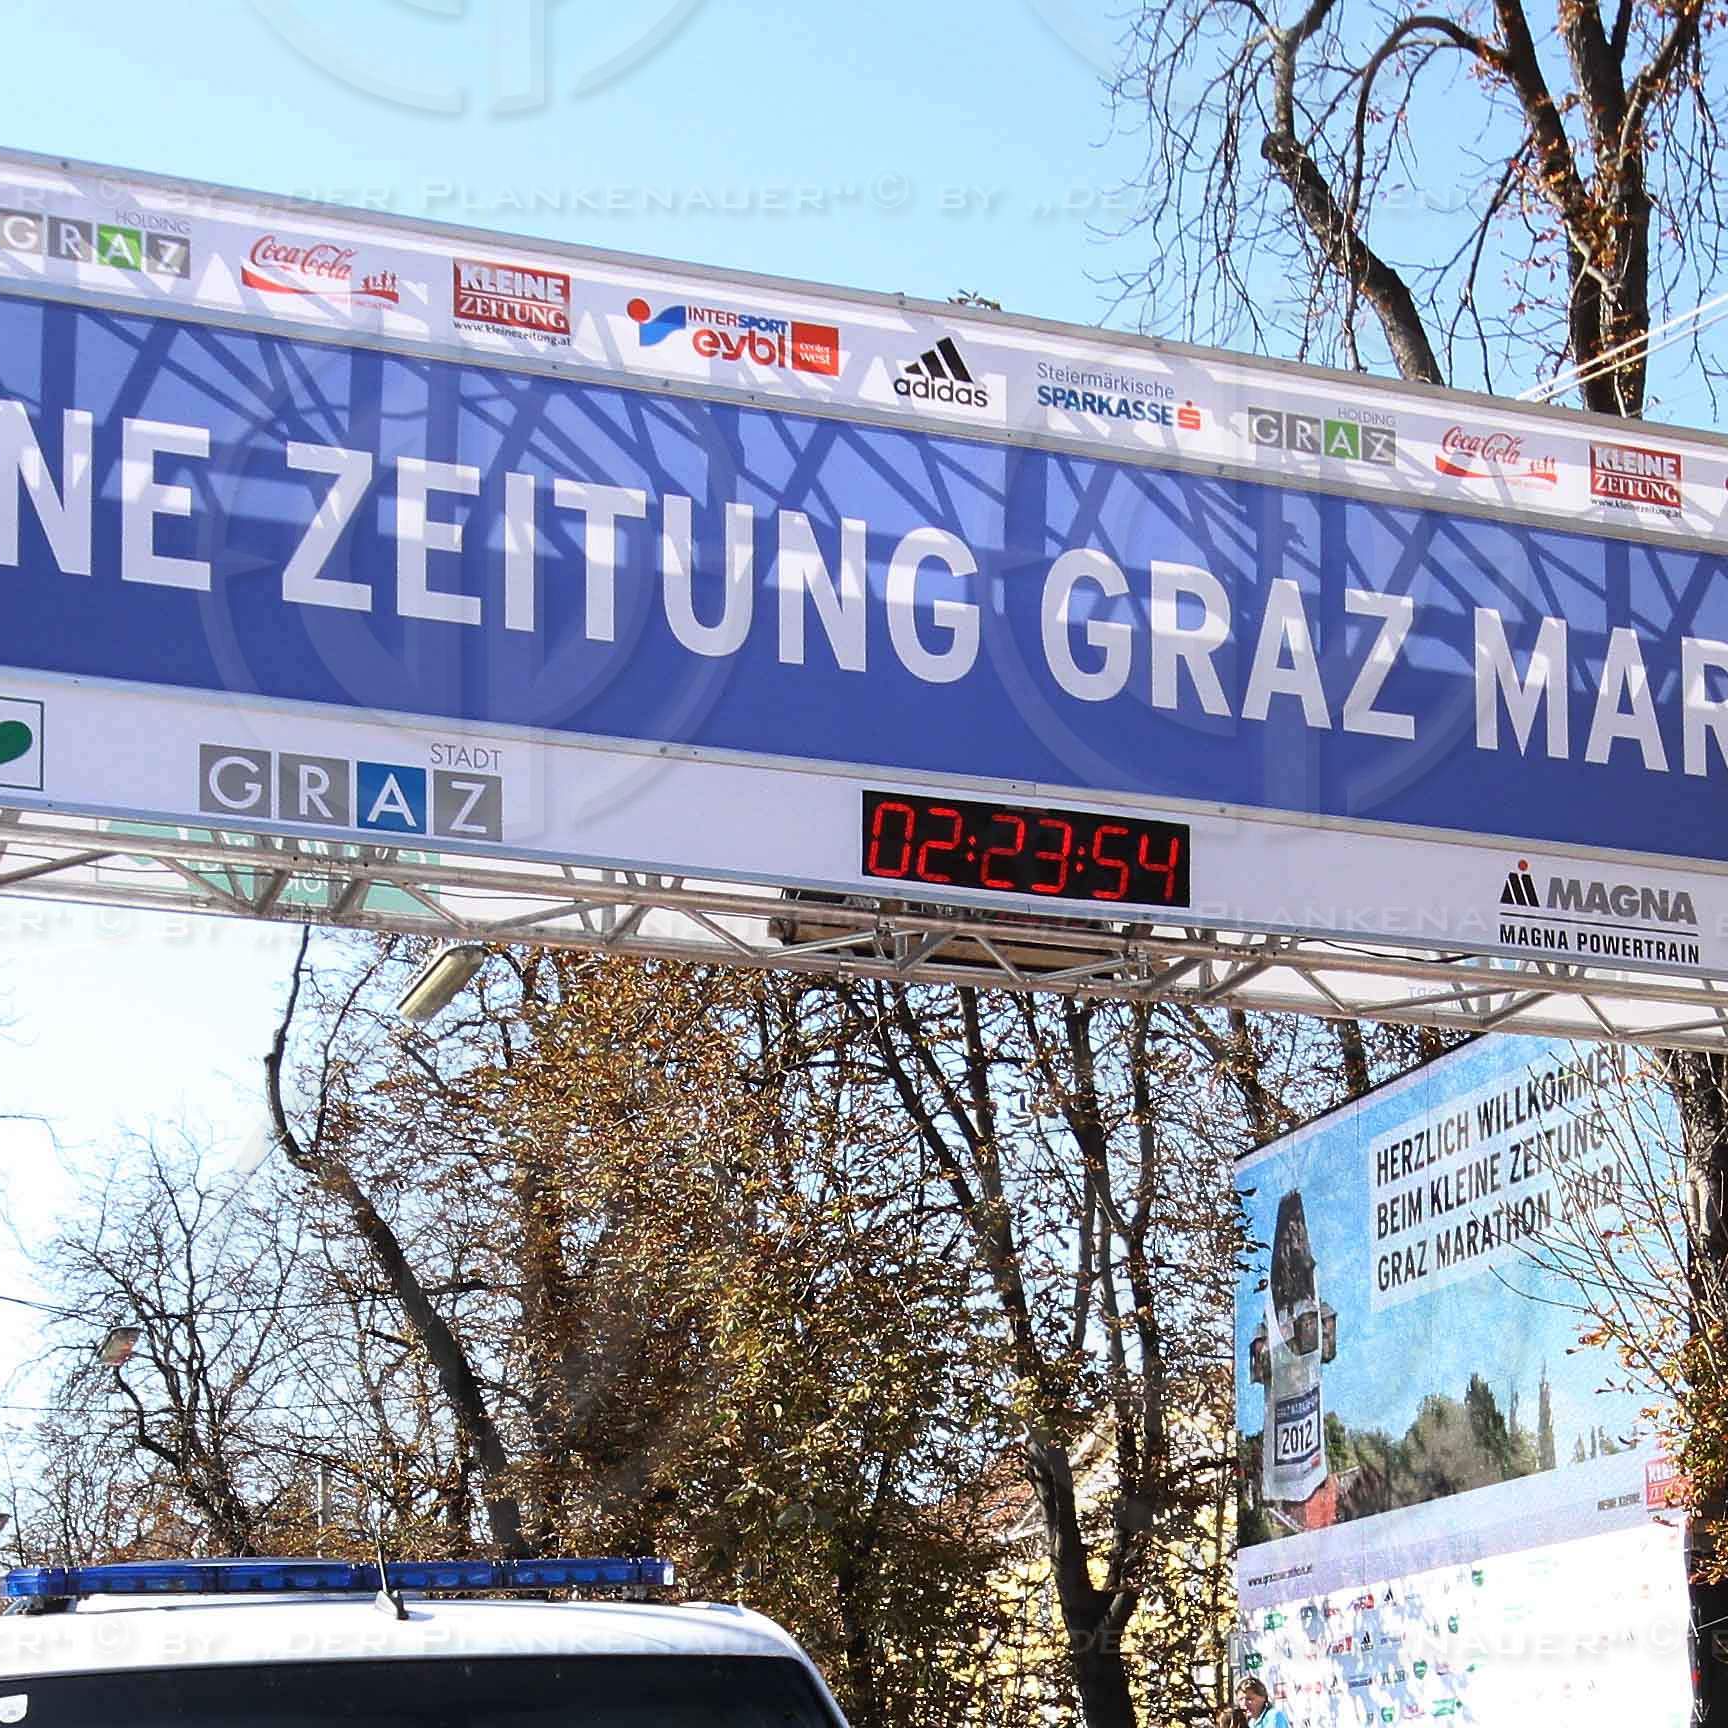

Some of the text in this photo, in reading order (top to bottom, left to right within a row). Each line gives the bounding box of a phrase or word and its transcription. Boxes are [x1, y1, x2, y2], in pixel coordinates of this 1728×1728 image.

[114, 208, 193, 236] HOLDING
[1, 213, 188, 274] GRAZ
[459, 262, 567, 304] KLEINE
[459, 297, 568, 330] ZEITUNG
[687, 304, 788, 336] INTERSPORT
[692, 327, 787, 370] eybl
[800, 351, 832, 367] west
[893, 375, 989, 410] adidas
[1036, 361, 1176, 400] Steiermärkische
[1036, 385, 1175, 429] SPARKASSE
[1337, 407, 1397, 429] HOLDING
[1250, 410, 1393, 463] GRAZ
[1595, 446, 1679, 482] KLEINE
[1595, 473, 1680, 503] ZEITUNG
[280, 440, 982, 685] ZEITUNG
[1039, 547, 1416, 741] GRAZ
[429, 742, 504, 772] STADT
[207, 754, 491, 835] GRAZ
[869, 799, 1179, 901] 02:23:54
[1546, 877, 1698, 926] MAGNA
[1499, 924, 1700, 964] MAGNA POWERTRAIN
[1375, 1043, 1629, 1189] HERZLICH WILLKOMMEN
[1375, 1110, 1606, 1241] BEIM KLEINE ZEITUNG
[1375, 1240, 1430, 1293] GRAZ
[1435, 1190, 1553, 1266] MARATHON
[1281, 1419, 1314, 1457] 2012
